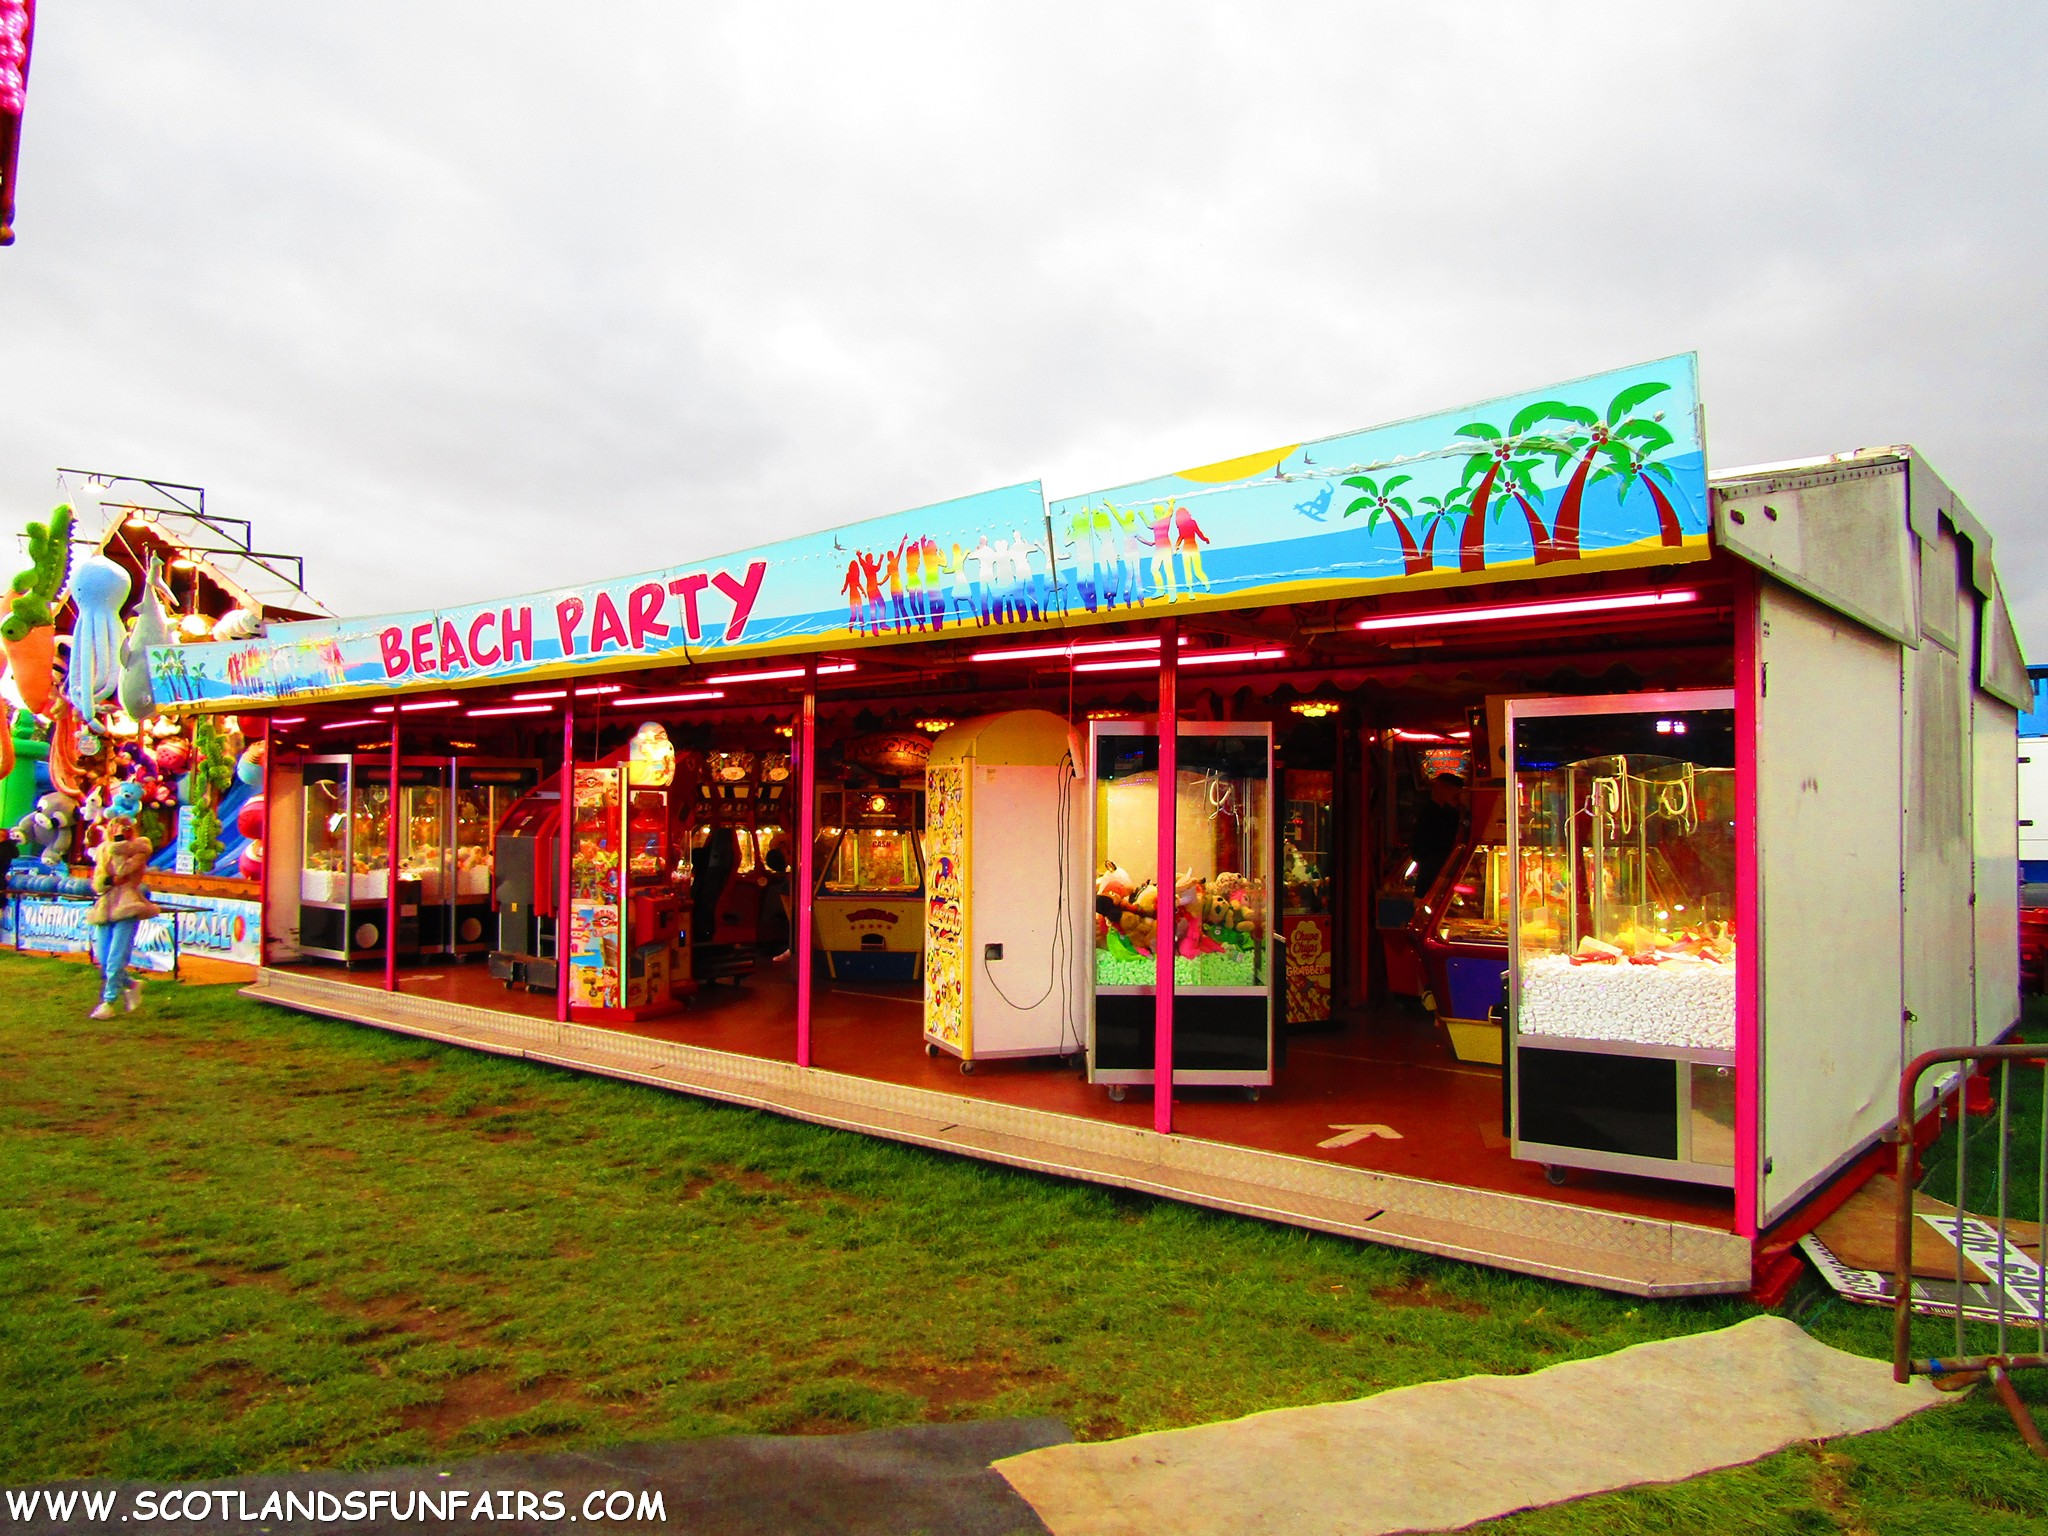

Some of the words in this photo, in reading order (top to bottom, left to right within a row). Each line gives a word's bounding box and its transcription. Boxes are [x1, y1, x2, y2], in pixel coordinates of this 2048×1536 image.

[379, 607, 534, 679] BEACH
[556, 561, 768, 656] PARTY
[1295, 930, 1319, 943] Chupa
[1286, 965, 1326, 977] GRABBER
